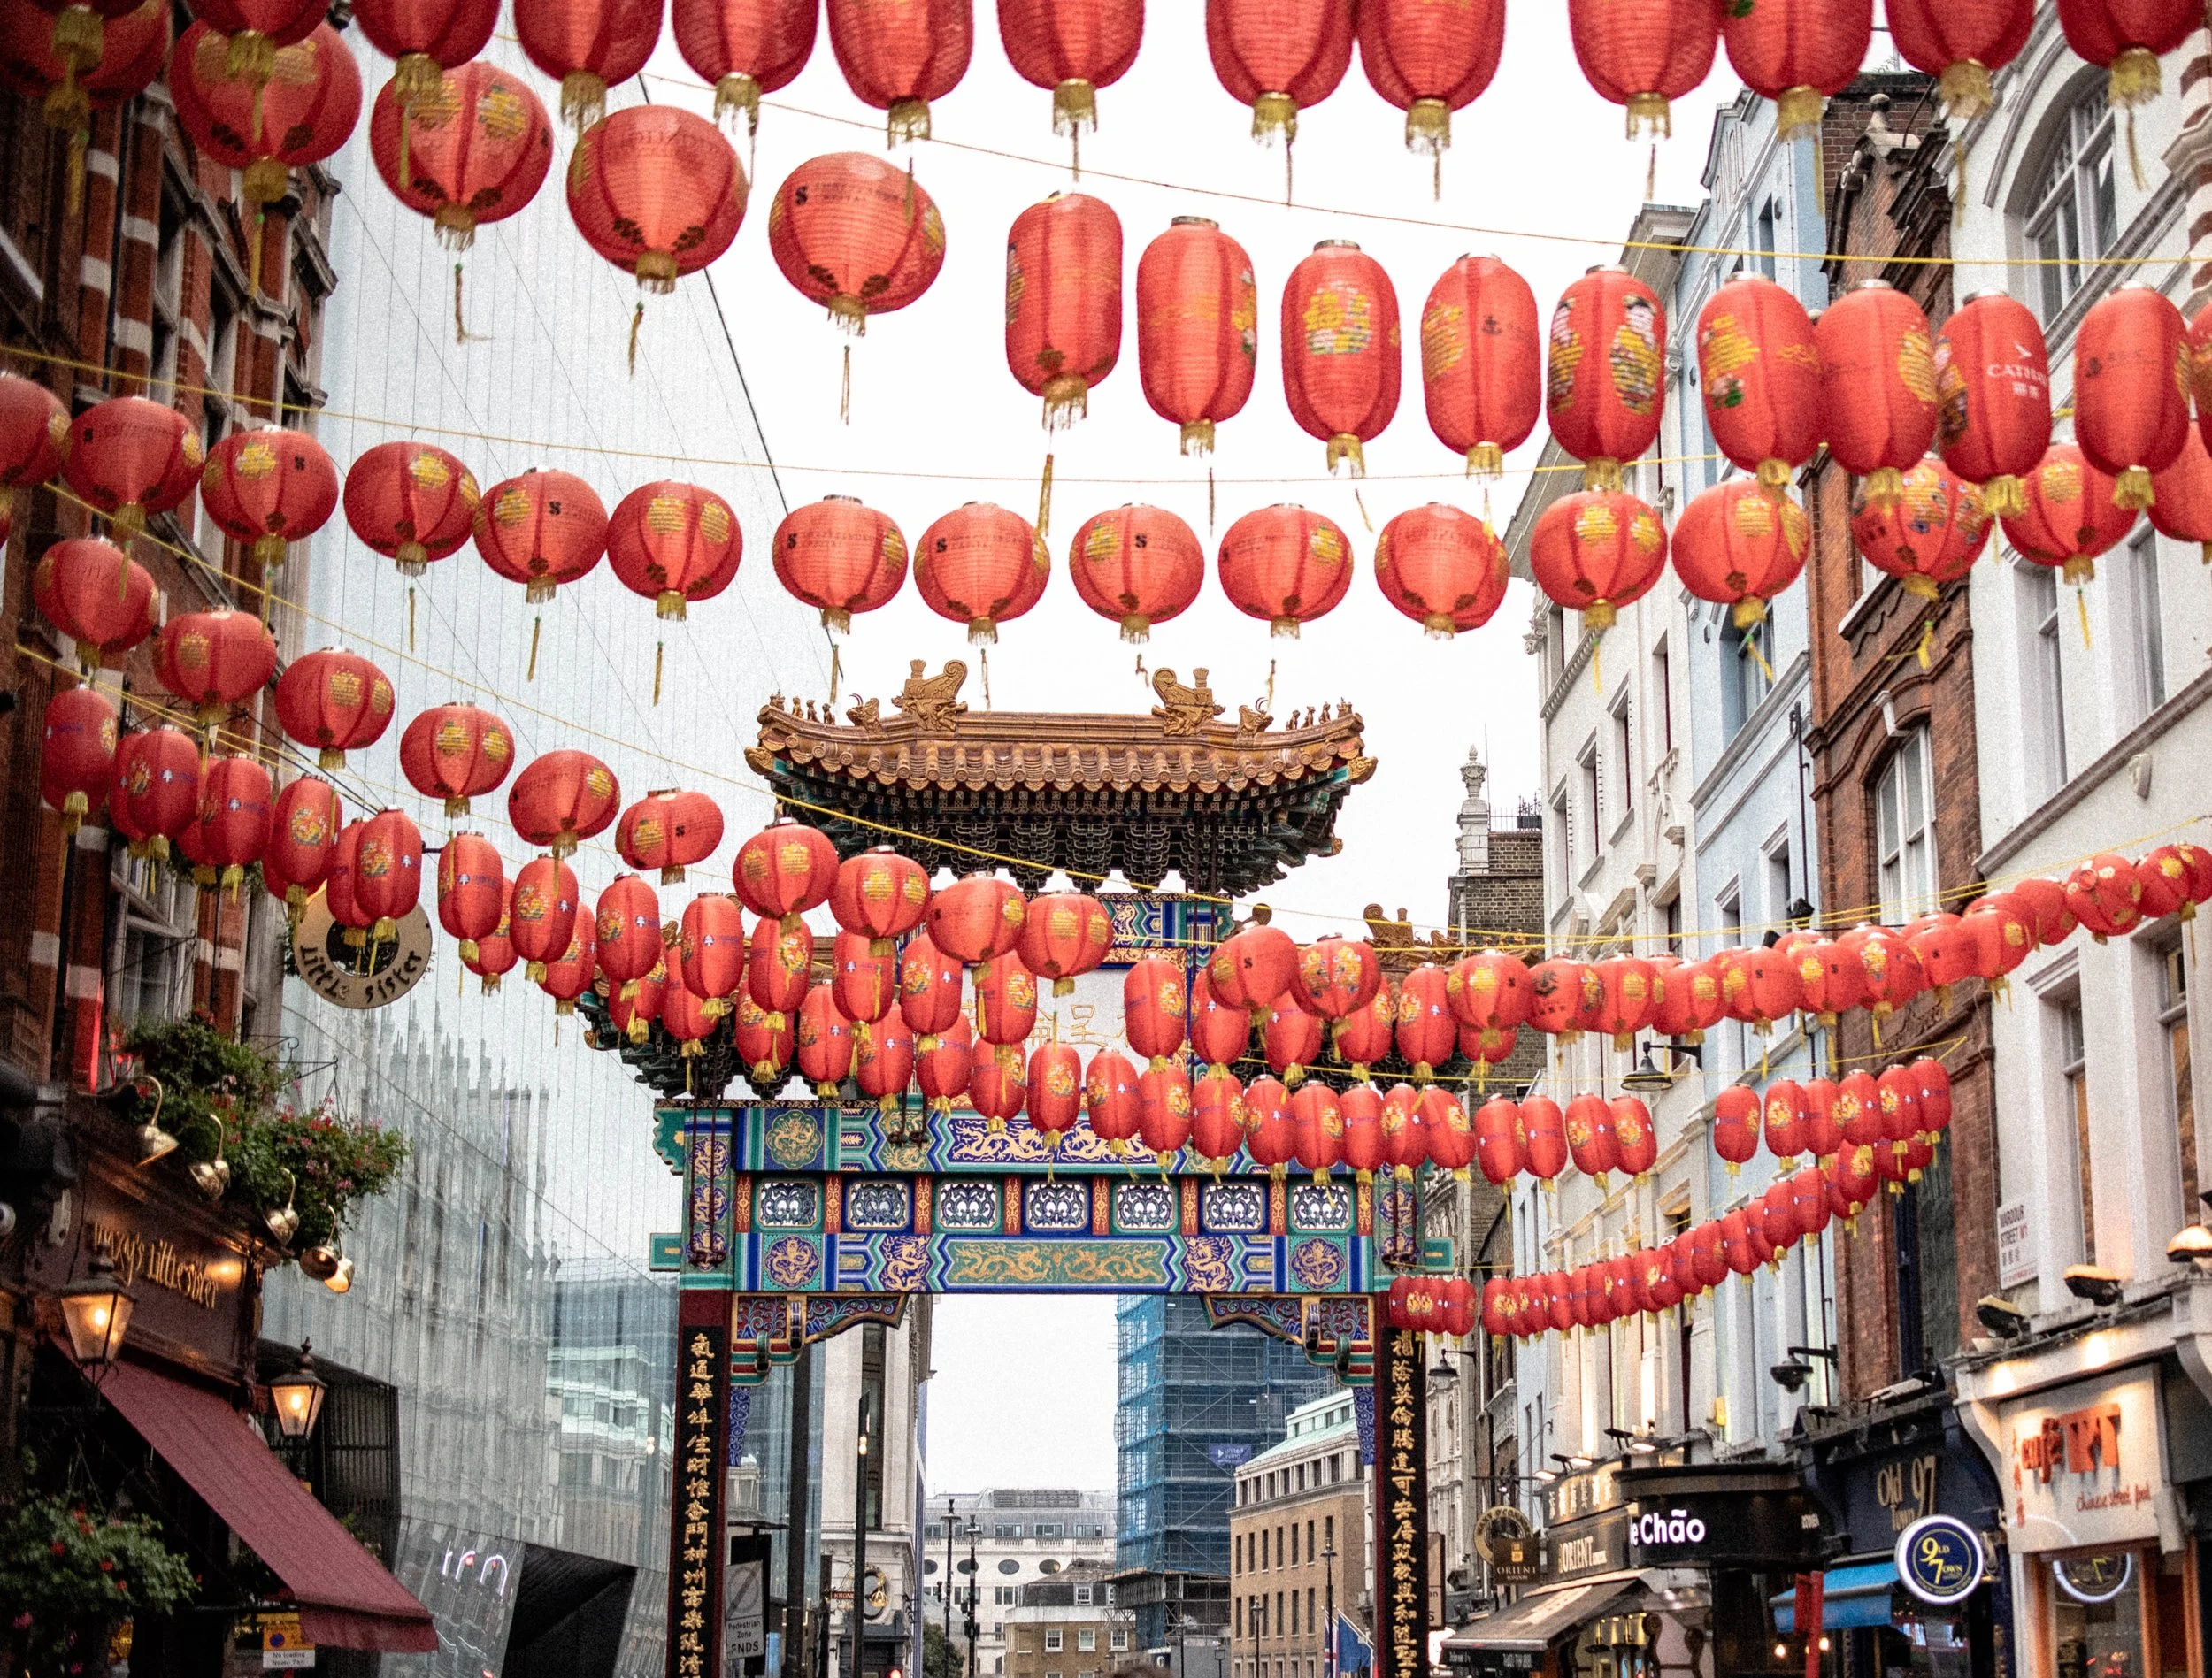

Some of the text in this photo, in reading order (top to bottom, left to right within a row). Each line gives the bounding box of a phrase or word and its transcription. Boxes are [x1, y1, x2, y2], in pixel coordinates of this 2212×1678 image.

[1877, 1462, 1903, 1507] Old
[1562, 1536, 1594, 1573] ORIENT
[1496, 1566, 1536, 1575] ORIENT
[727, 1620, 761, 1630] Pedestrian
